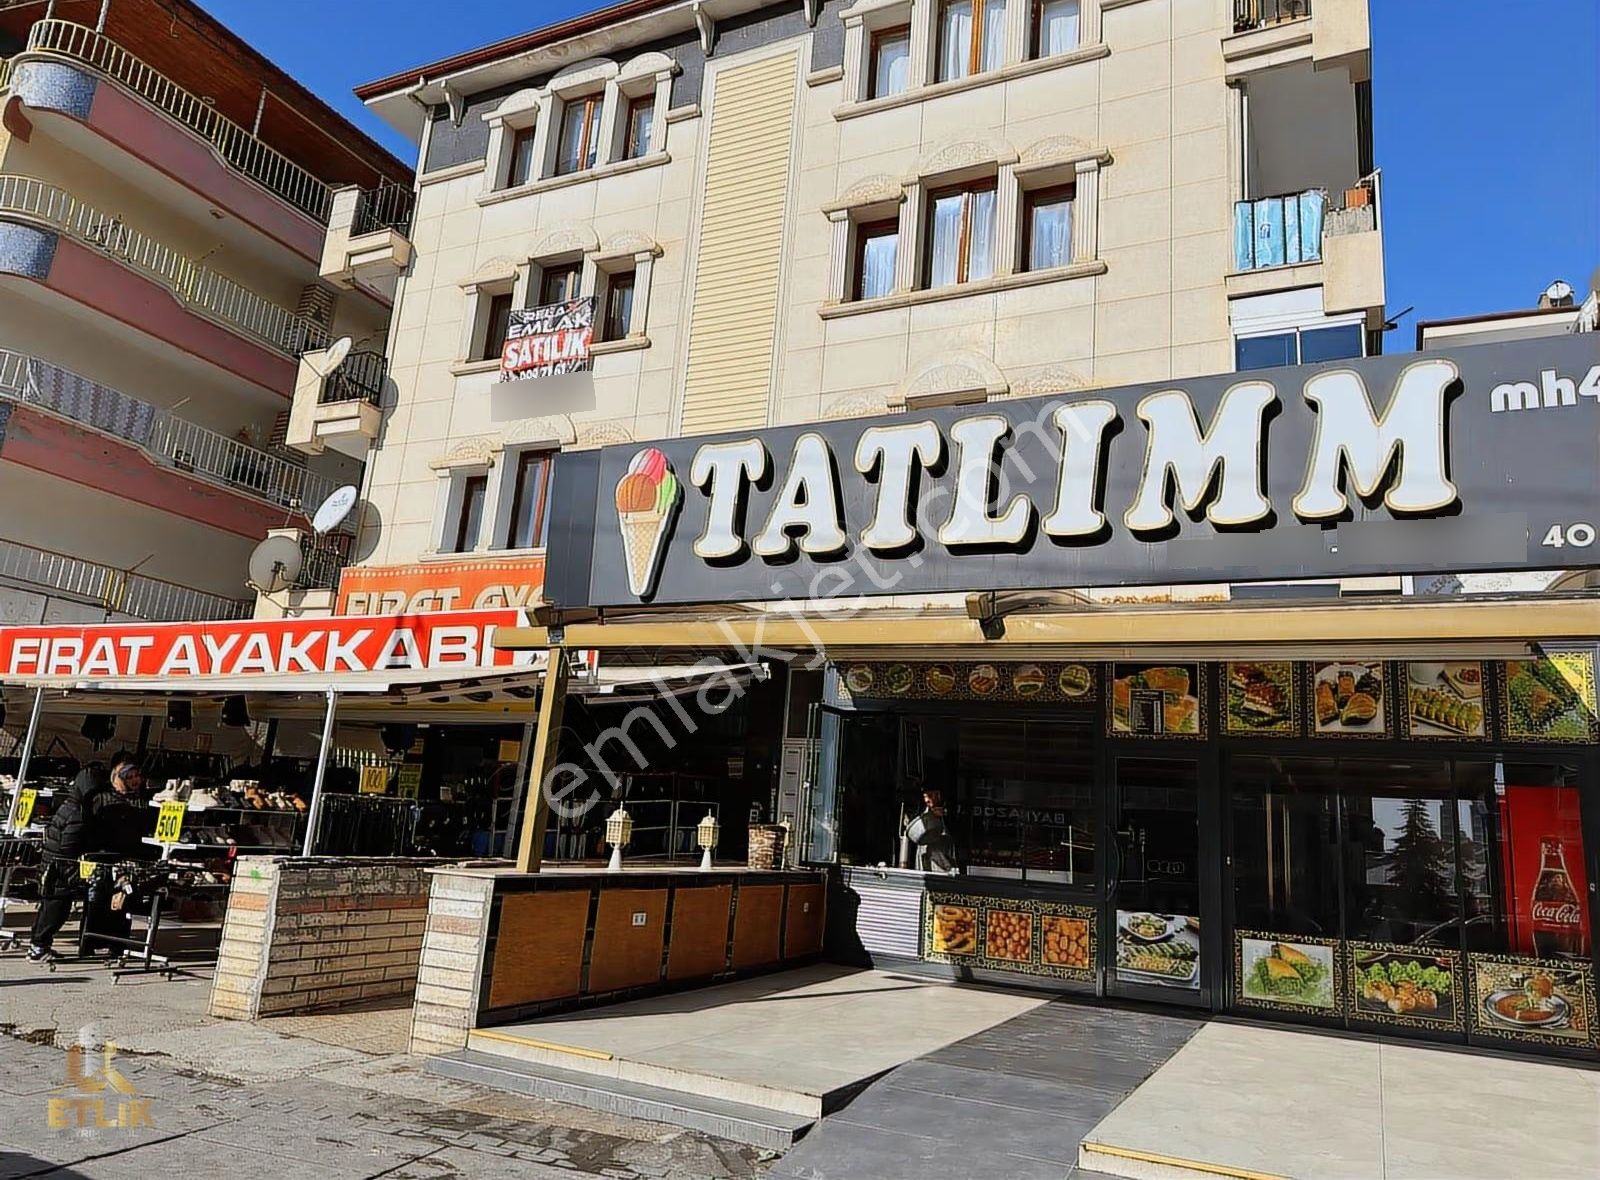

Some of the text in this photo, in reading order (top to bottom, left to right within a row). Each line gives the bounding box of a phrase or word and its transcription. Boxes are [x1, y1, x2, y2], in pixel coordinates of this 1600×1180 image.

[508, 313, 591, 340] EMLAK
[503, 330, 588, 369] SATILIK
[690, 359, 1460, 564] TATLIMM
[1541, 522, 1596, 549] 40
[8, 624, 502, 676] FIRAT AYAKKABI
